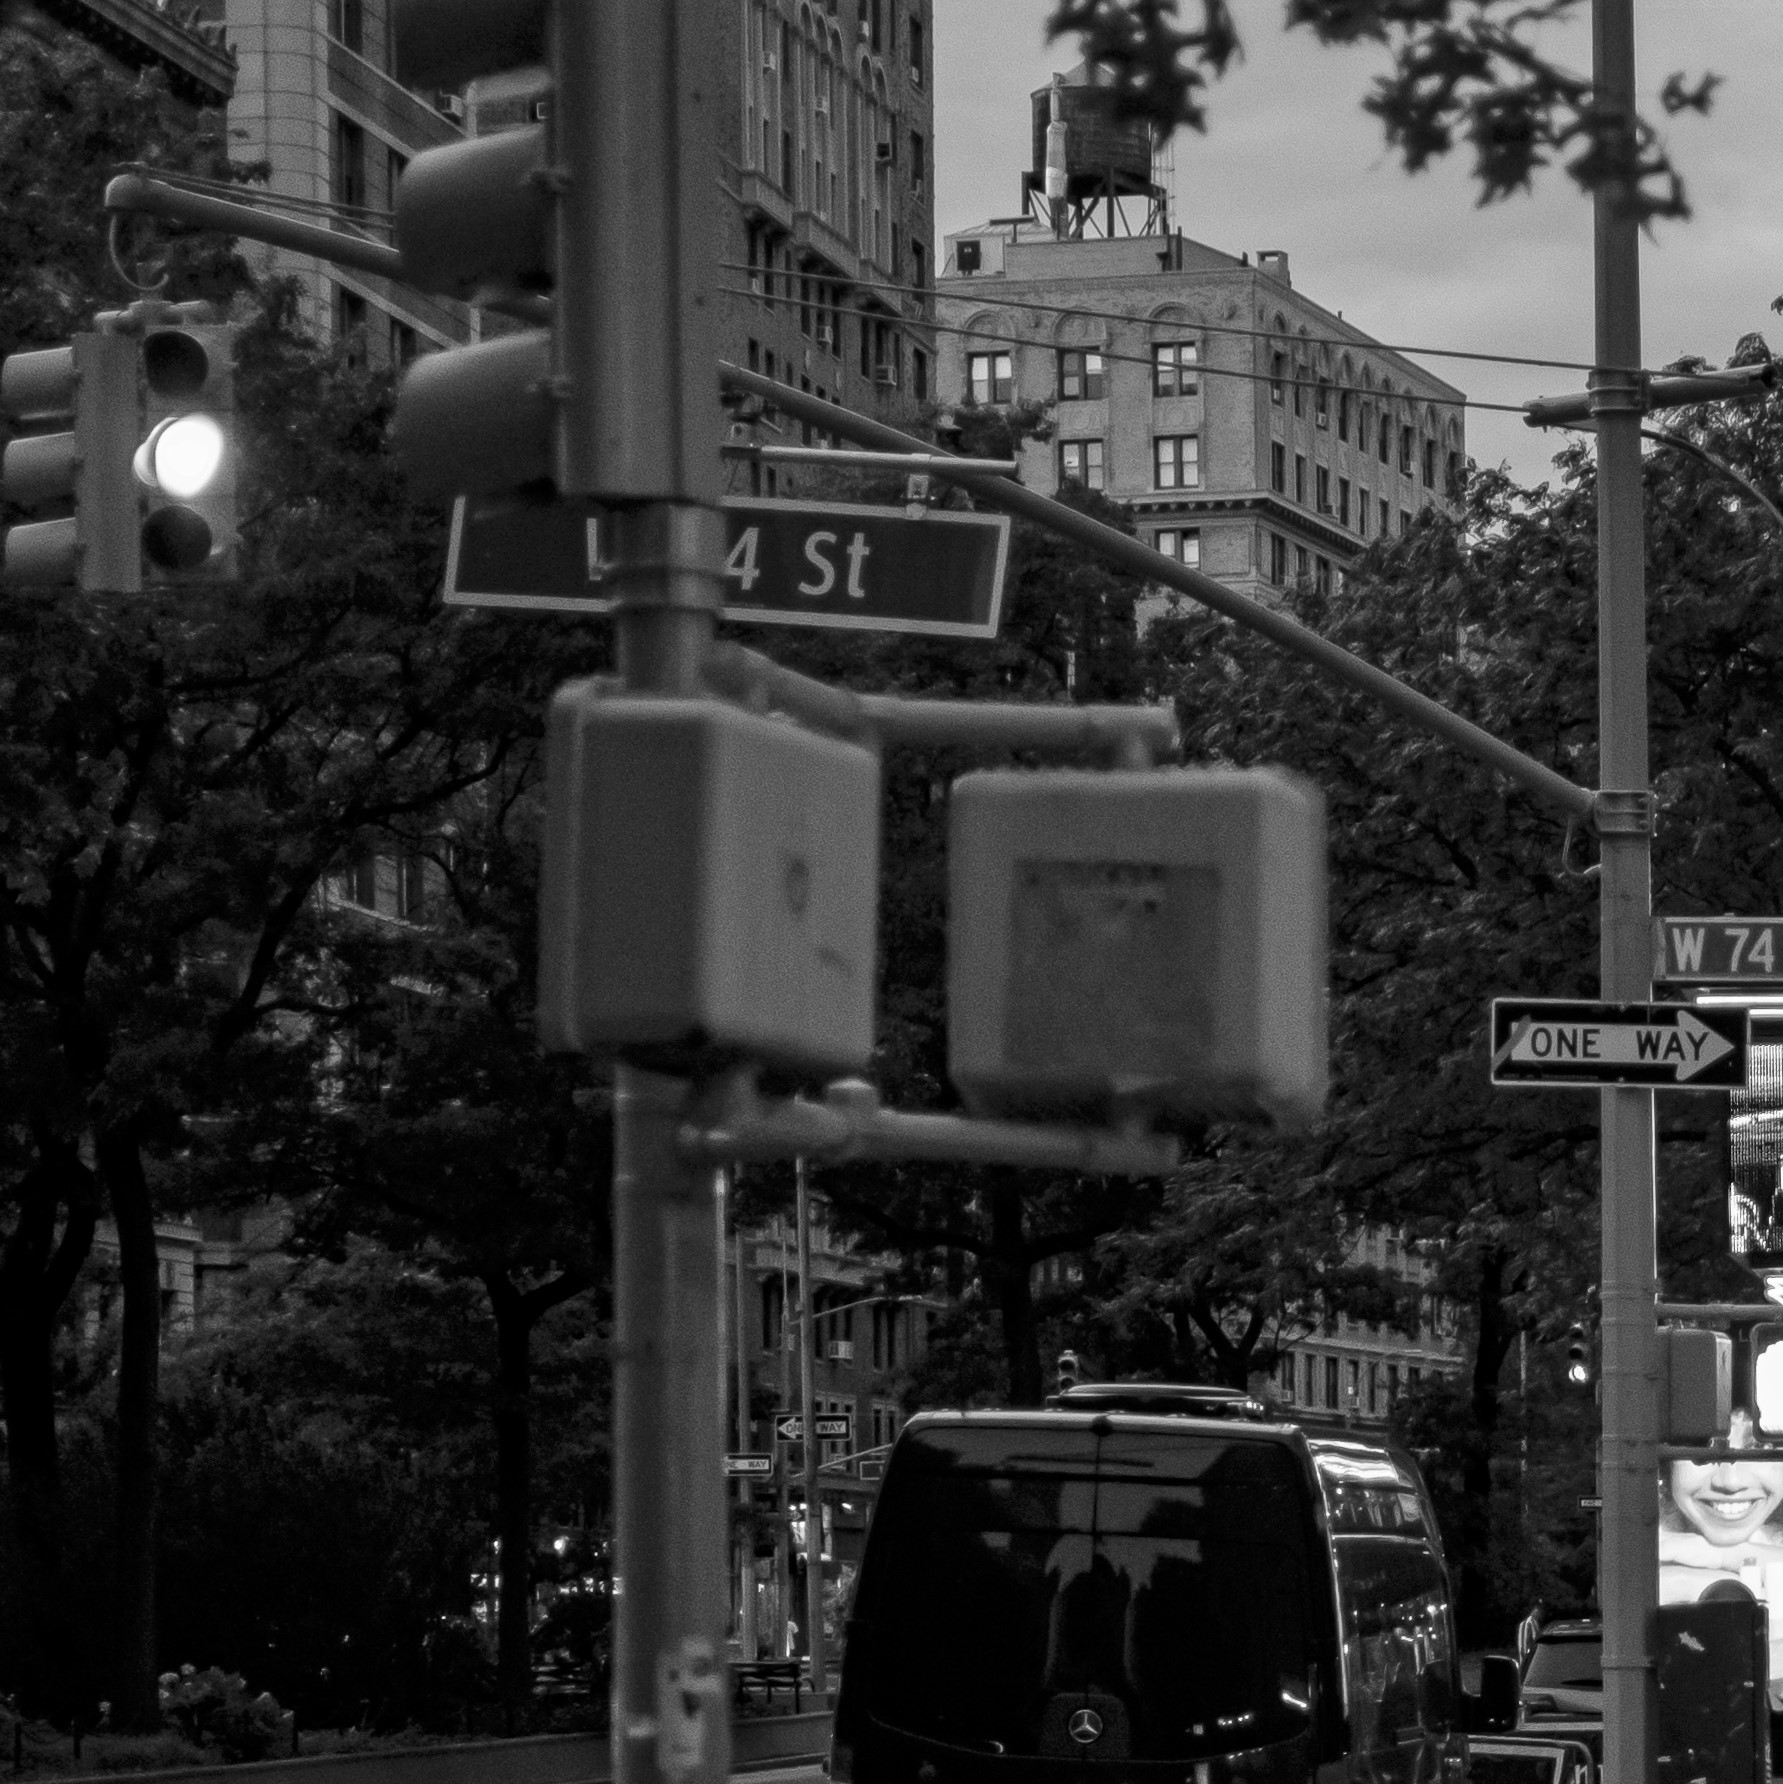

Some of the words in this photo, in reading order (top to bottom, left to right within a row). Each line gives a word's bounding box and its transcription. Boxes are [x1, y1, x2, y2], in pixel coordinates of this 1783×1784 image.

[723, 528, 760, 591] 4
[797, 530, 870, 598] St
[1672, 927, 1705, 973] W
[1724, 927, 1775, 973] 74
[1531, 1026, 1600, 1059] ONE
[1636, 1030, 1710, 1061] WAY
[820, 1422, 844, 1432] WAY
